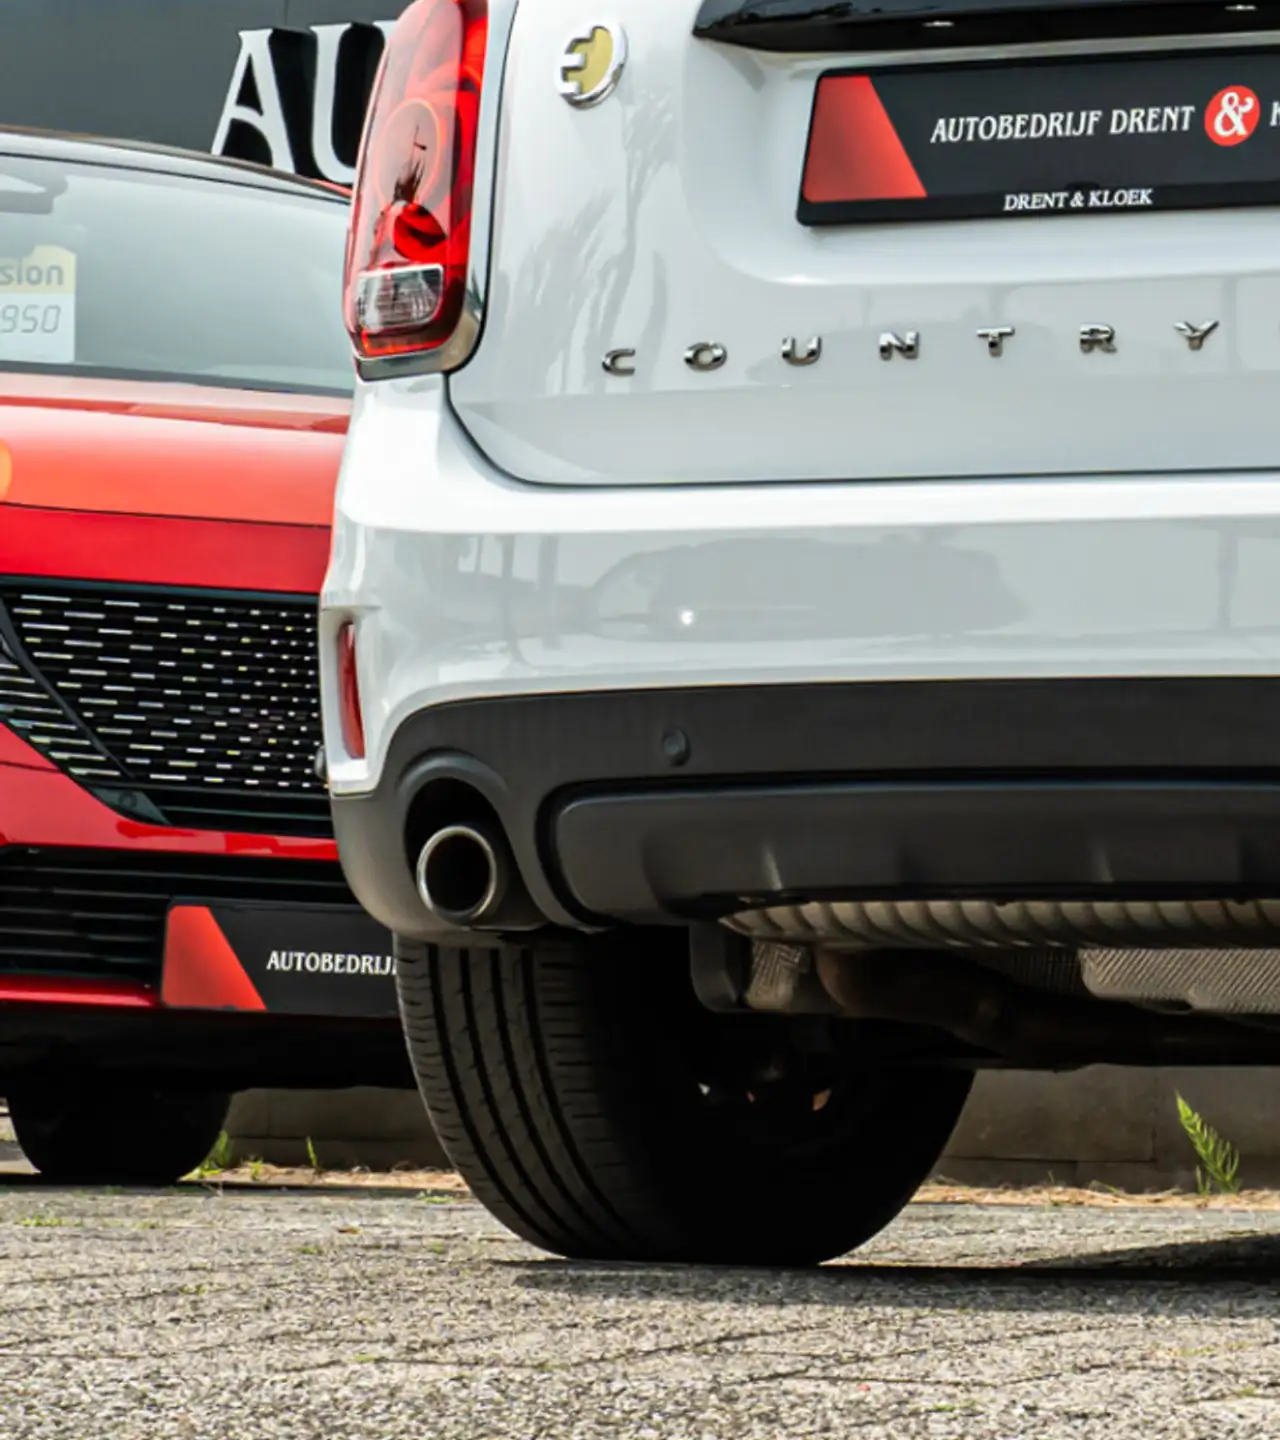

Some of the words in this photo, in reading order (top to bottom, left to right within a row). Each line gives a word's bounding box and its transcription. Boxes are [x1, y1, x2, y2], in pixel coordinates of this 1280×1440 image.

[930, 108, 1102, 144] AUTOBEDRIJF
[1108, 105, 1196, 136] DRENT
[1213, 91, 1255, 138] &
[1003, 191, 1069, 211] DRENT
[1070, 190, 1085, 208] &
[1088, 188, 1154, 207] KLOEK
